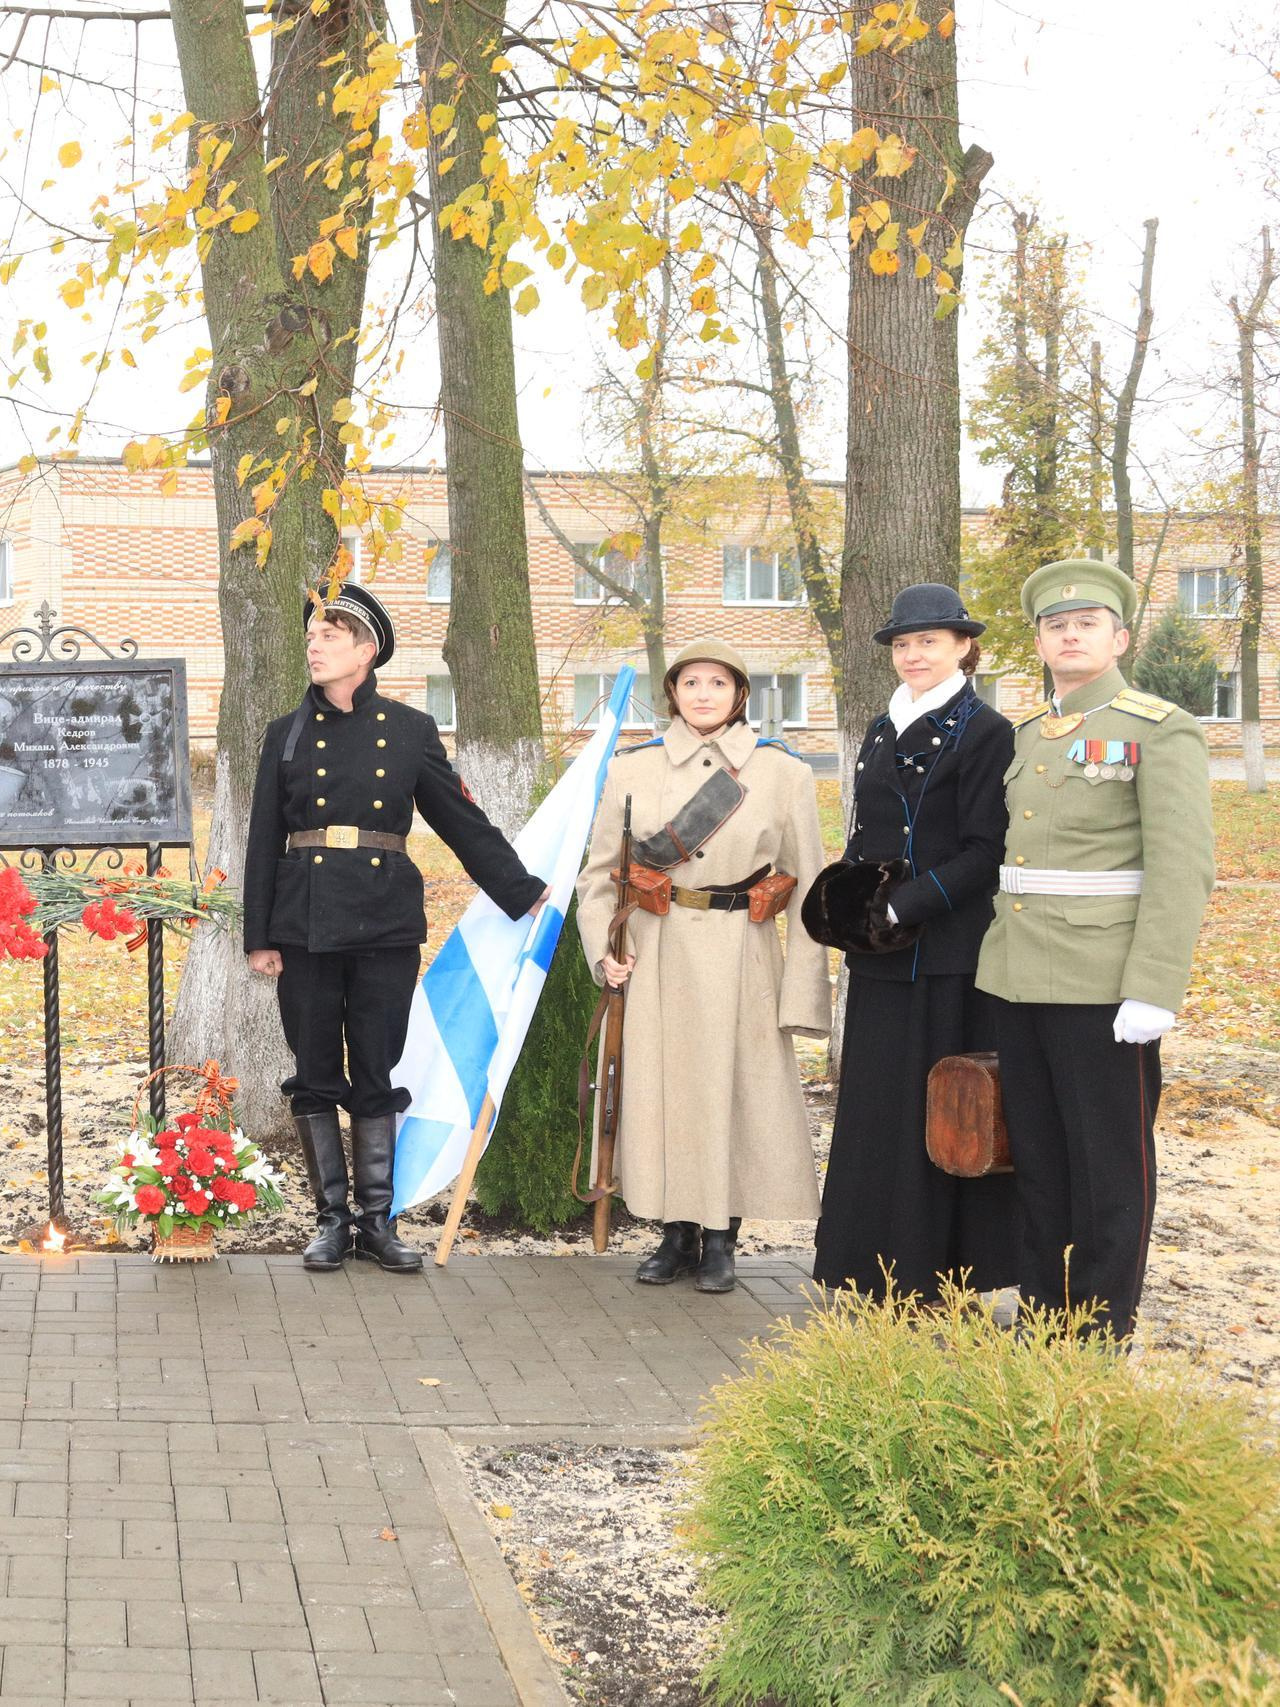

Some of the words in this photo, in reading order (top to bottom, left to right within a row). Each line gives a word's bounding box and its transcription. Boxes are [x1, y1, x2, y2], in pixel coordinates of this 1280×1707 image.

[33, 712, 122, 727] Вице-адмирал
[57, 728, 96, 739] Кедров
[14, 742, 55, 752] Михаил
[43, 758, 69, 769] 1878
[84, 757, 109, 769] 1945
